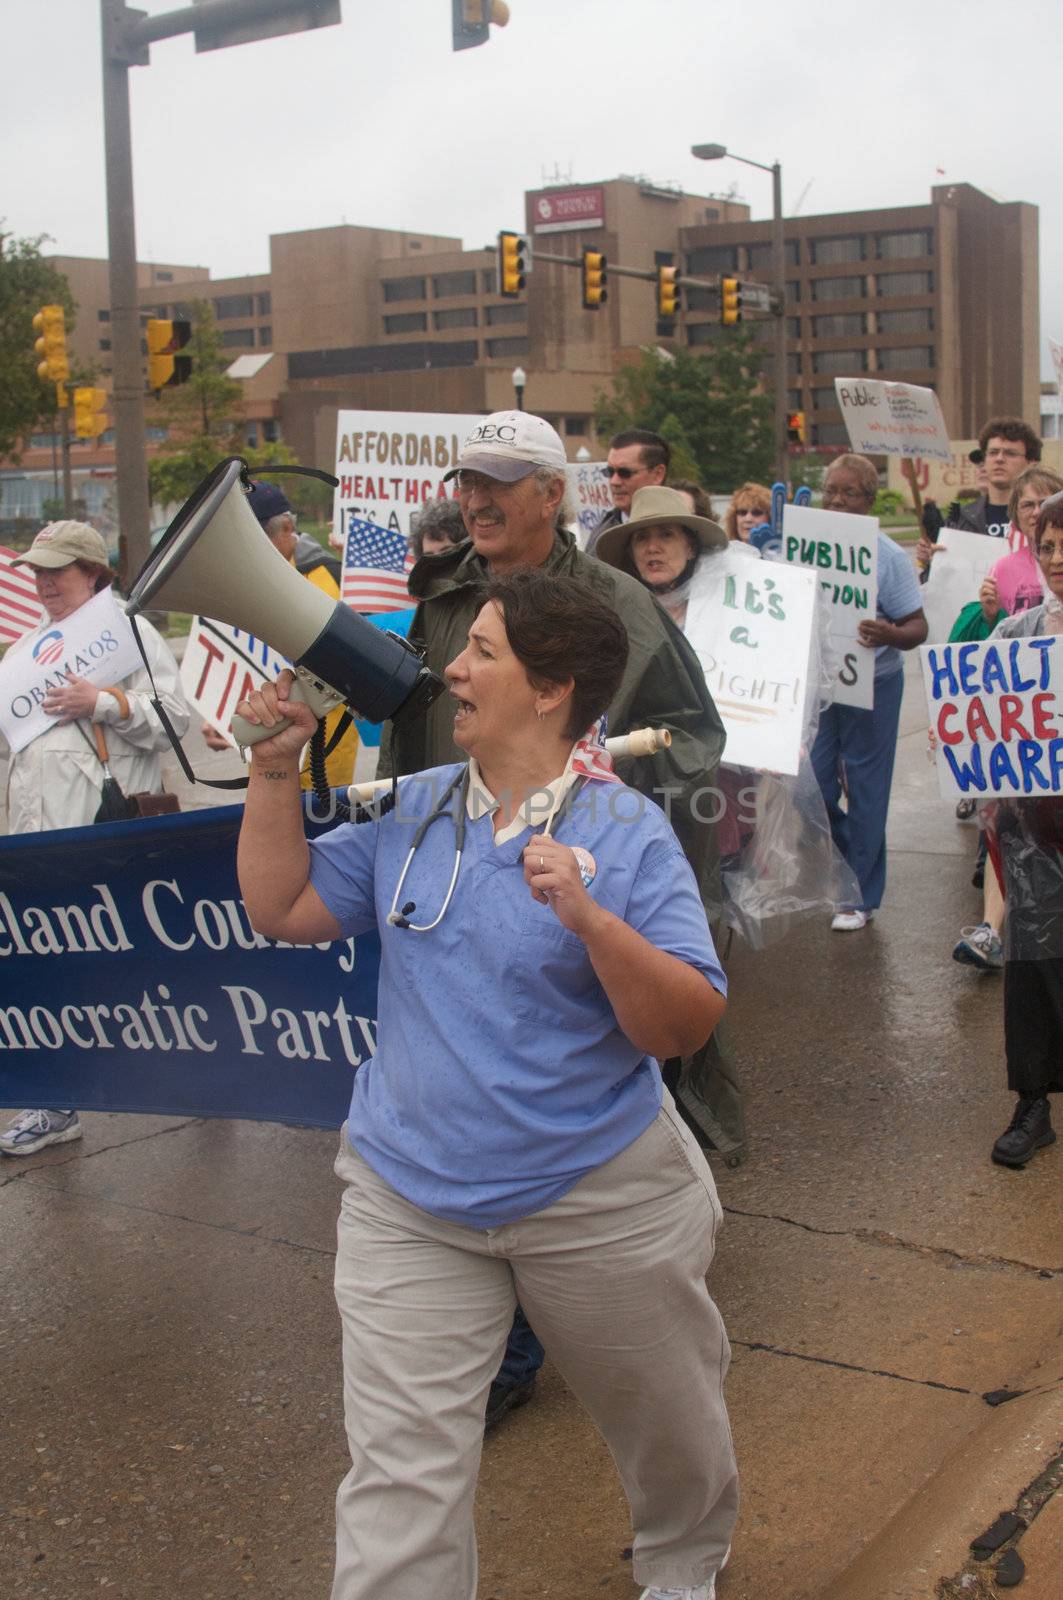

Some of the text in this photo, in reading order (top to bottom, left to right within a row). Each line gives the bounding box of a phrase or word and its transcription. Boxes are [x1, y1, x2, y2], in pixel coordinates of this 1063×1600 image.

[339, 430, 461, 468] AFFORDABL
[578, 484, 613, 508] SHAR
[786, 535, 872, 576] PUBLIC
[722, 569, 786, 620] It's
[729, 626, 758, 648] a
[839, 653, 858, 686] S
[928, 636, 1056, 700] HEALT
[937, 692, 1059, 746] CARE
[142, 879, 355, 973] Couy
[0, 984, 218, 1052] mocratic
